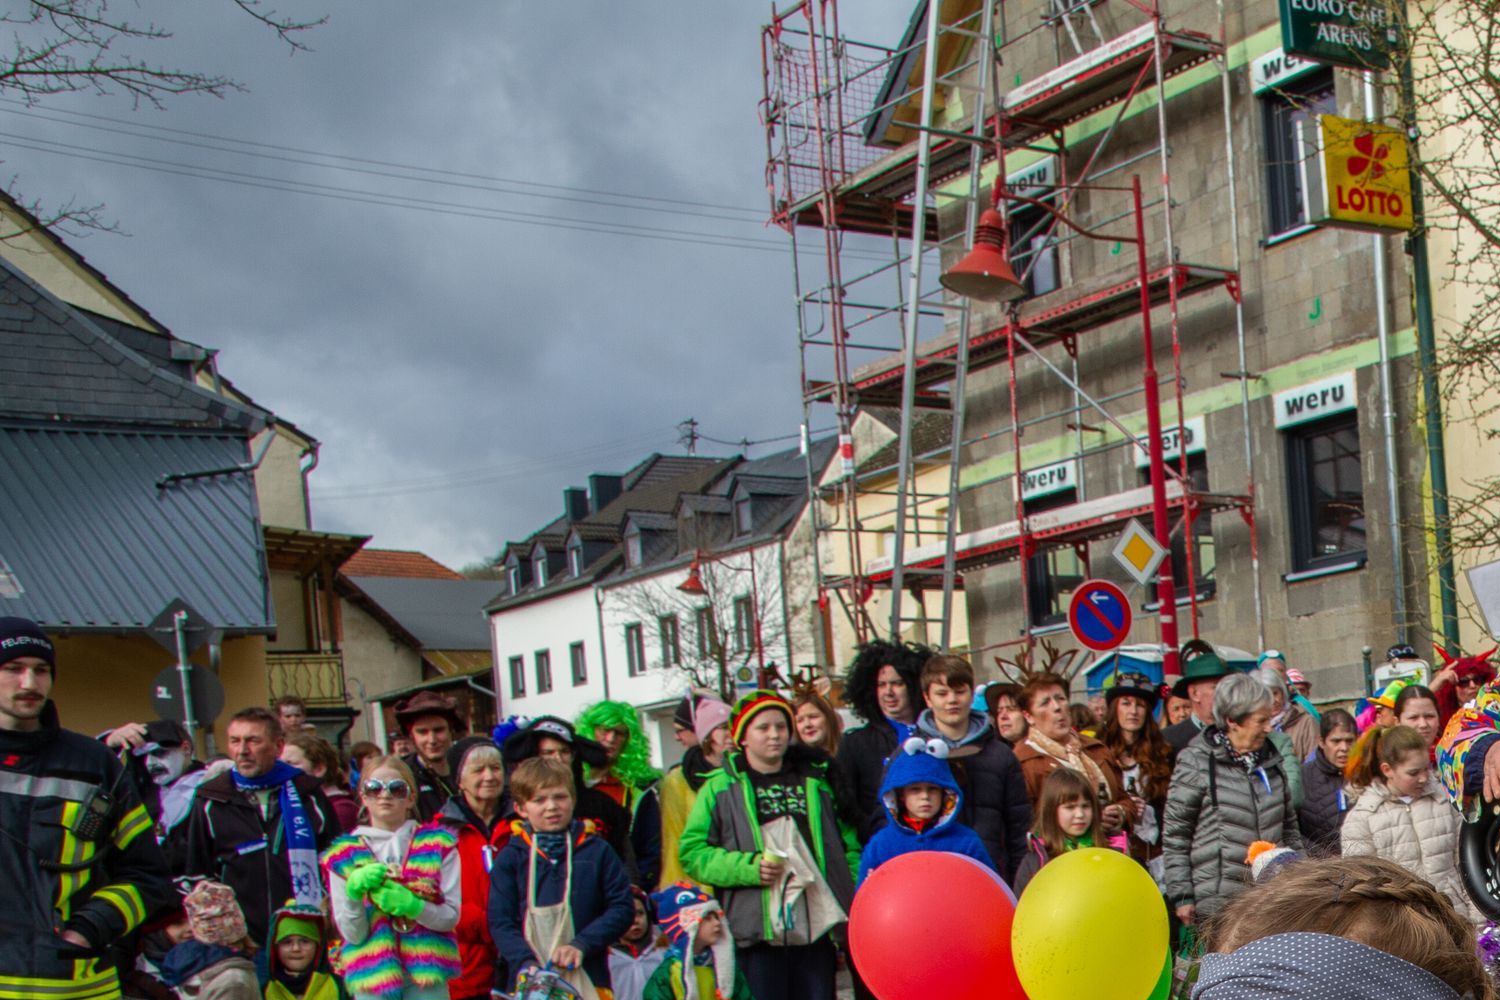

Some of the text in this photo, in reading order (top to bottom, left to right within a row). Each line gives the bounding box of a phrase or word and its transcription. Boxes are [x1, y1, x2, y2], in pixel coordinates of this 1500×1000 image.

[1316, 22, 1372, 50] ARENS
[1336, 184, 1404, 218] LOTTO
[1284, 383, 1345, 417] weru
[1022, 466, 1067, 492] weru
